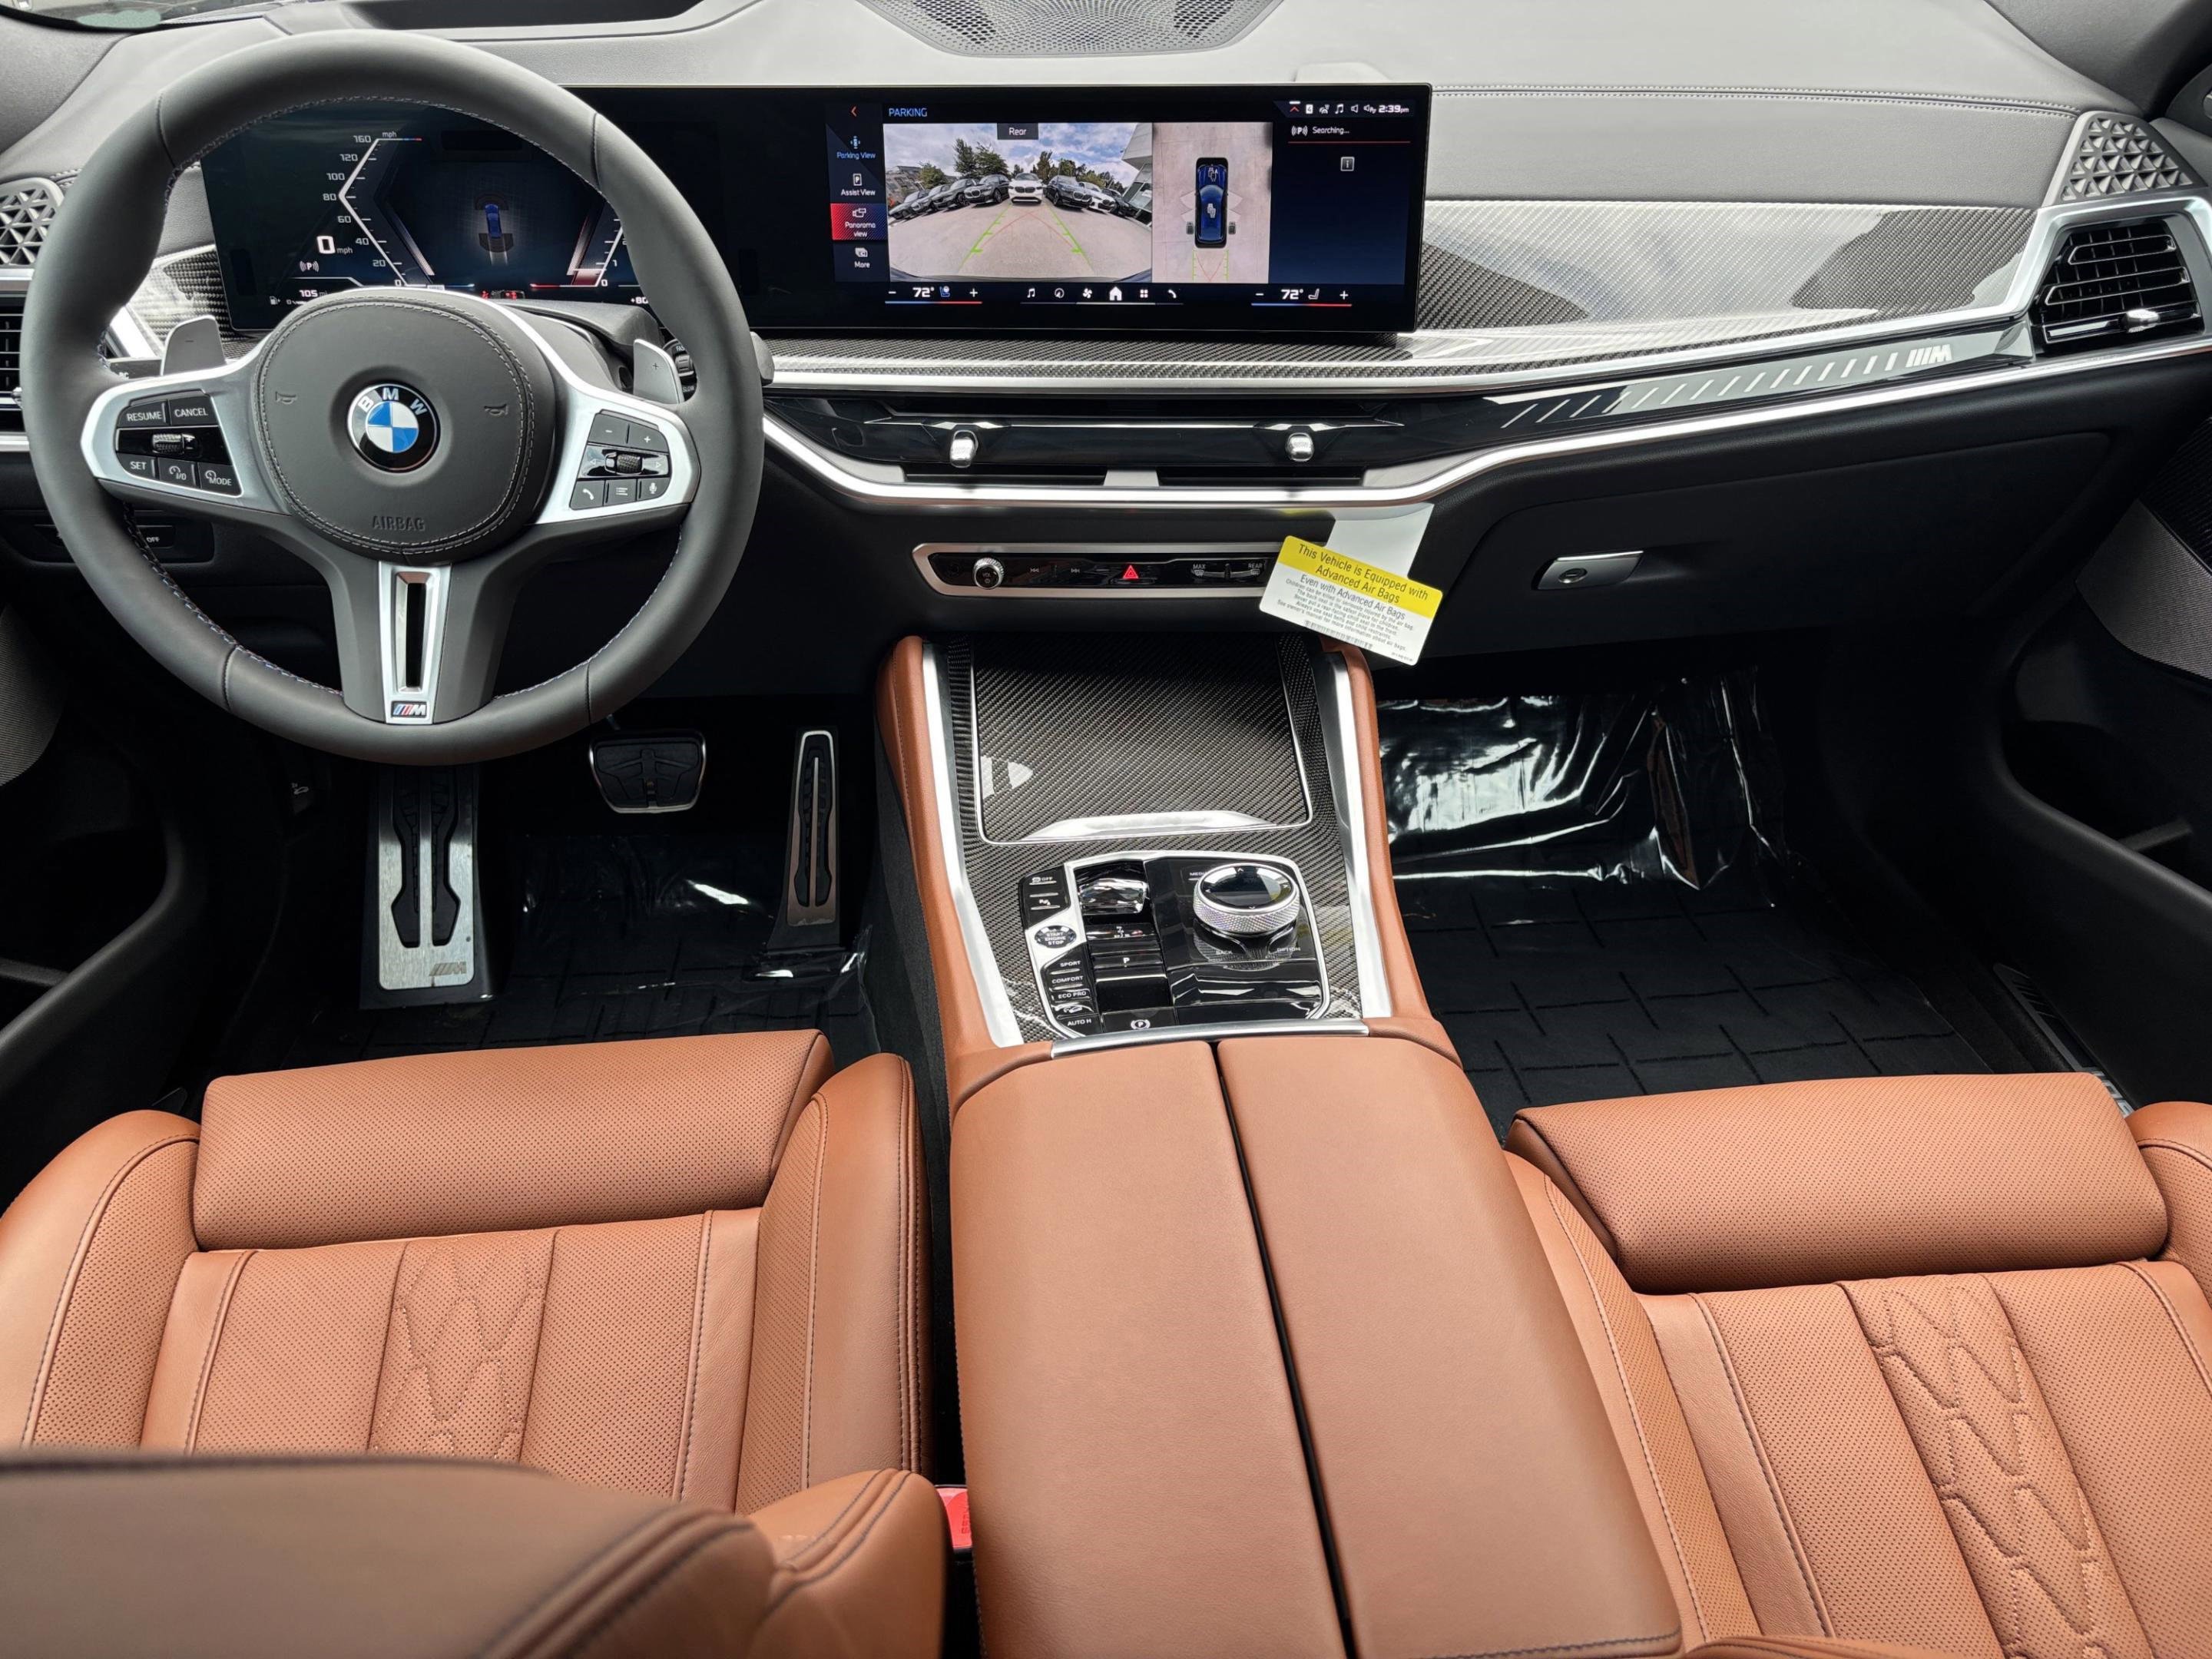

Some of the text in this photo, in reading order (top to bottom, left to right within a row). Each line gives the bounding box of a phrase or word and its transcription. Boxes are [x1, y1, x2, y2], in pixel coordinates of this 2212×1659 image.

[889, 108, 928, 118] PARKING
[1008, 127, 1027, 136] Rear
[836, 151, 858, 160] Parking
[316, 236, 336, 254] 0
[358, 387, 428, 416] BMW
[127, 411, 163, 422] RESUME
[174, 408, 209, 418] CANCEL
[130, 461, 147, 470] SET
[209, 477, 232, 486] MODE
[373, 515, 426, 531] AIRBAG
[1299, 543, 1428, 600] This Vehicle is Equipped with
[1315, 565, 1399, 603] Advanced Air Bags
[1300, 574, 1406, 620] Even with Advanced Air Bags
[1051, 975, 1084, 984] COMFORT
